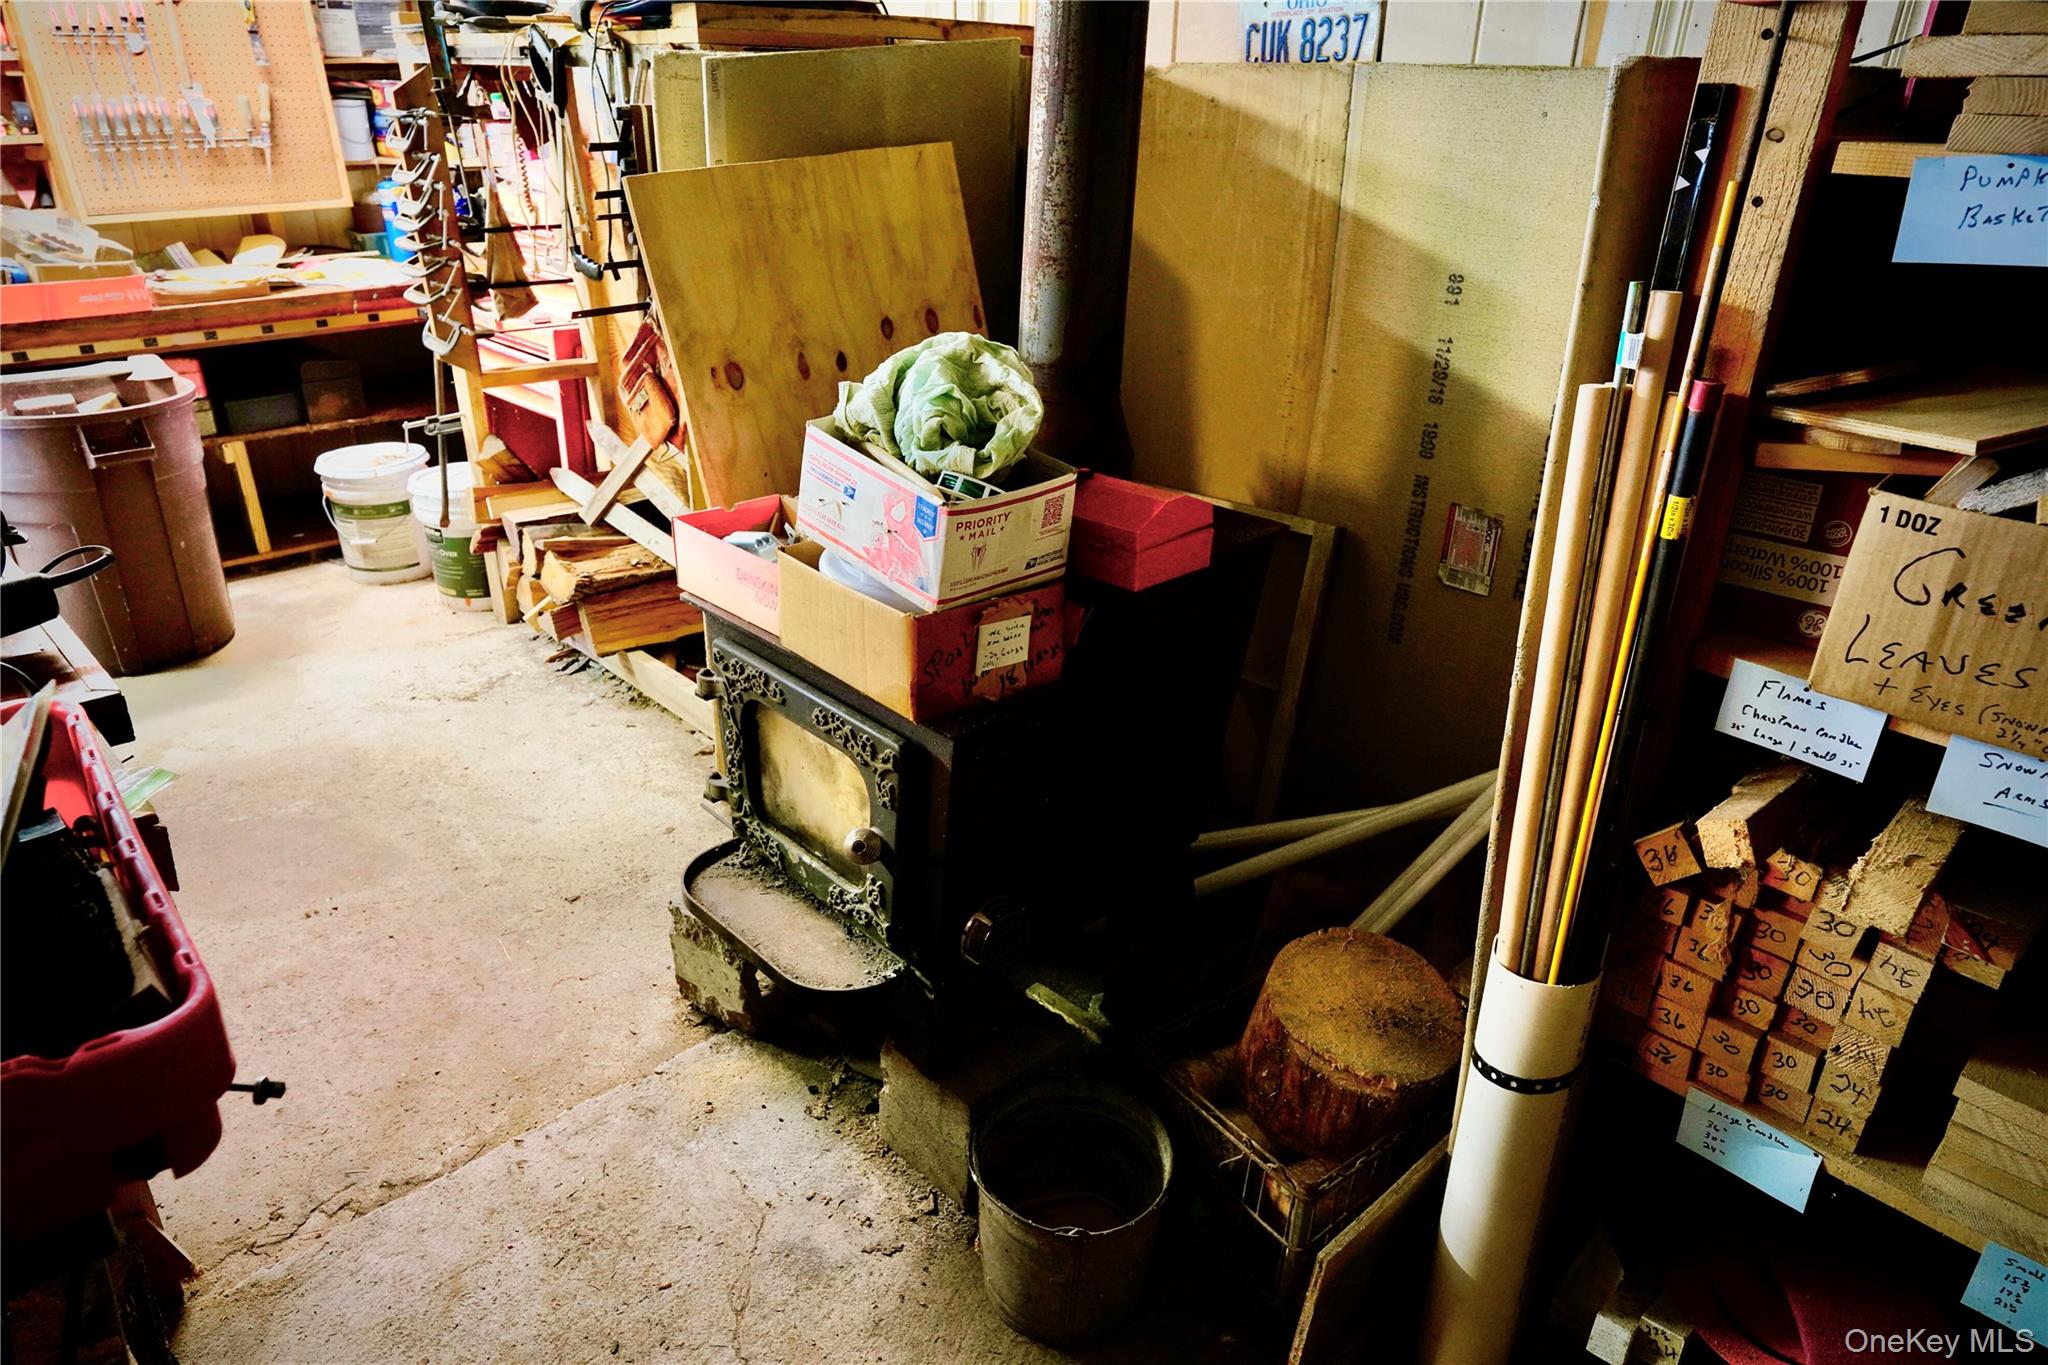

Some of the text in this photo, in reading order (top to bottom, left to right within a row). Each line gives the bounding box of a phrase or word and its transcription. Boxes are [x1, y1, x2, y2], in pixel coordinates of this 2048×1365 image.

[1245, 13, 1369, 63] CUK 8237
[955, 512, 1010, 532] PRIORITY
[1880, 505, 1942, 536] 1 DOZ
[968, 528, 996, 541] MAIL
[1790, 555, 1843, 579] 100%
[1778, 571, 1829, 594] 100%
[1845, 614, 2038, 689] LEAVES
[1704, 1062, 1728, 1078] 30
[1772, 1051, 1797, 1069] 30
